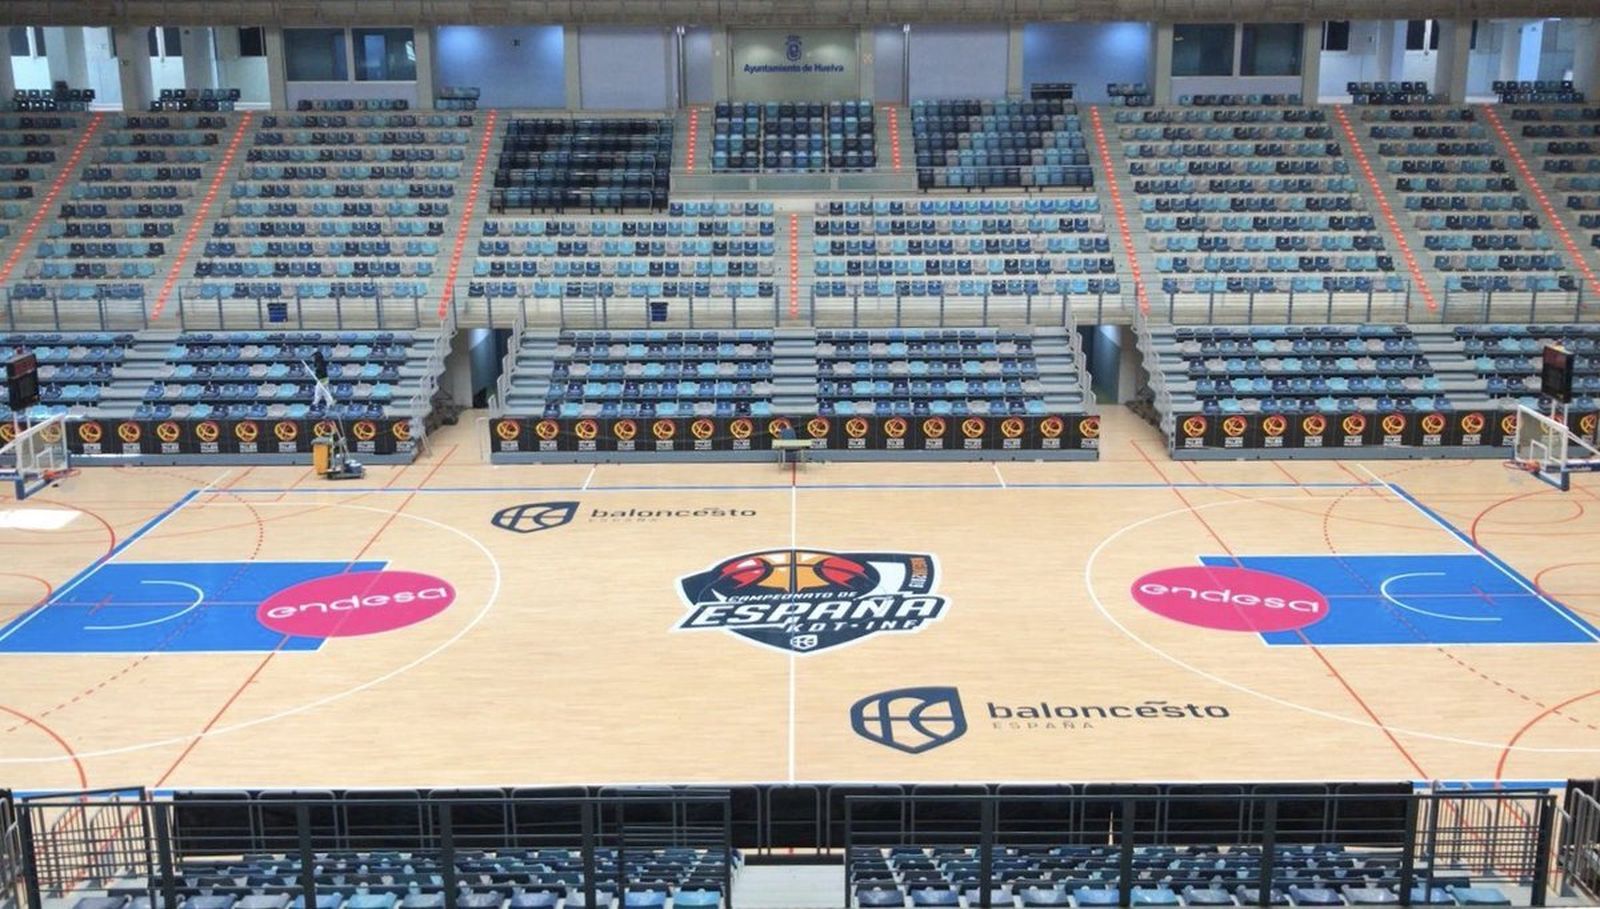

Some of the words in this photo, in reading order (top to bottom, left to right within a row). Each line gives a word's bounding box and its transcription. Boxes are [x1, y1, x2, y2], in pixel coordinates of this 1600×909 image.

[743, 64, 801, 75] Ayuntamiento
[802, 64, 812, 73] de
[814, 64, 844, 73] Huelva
[267, 586, 447, 619] endesa
[691, 595, 934, 626] ESPAÑA
[728, 592, 833, 603] CAMPEONATO
[837, 590, 859, 598] DE
[1140, 583, 1320, 613] endesa
